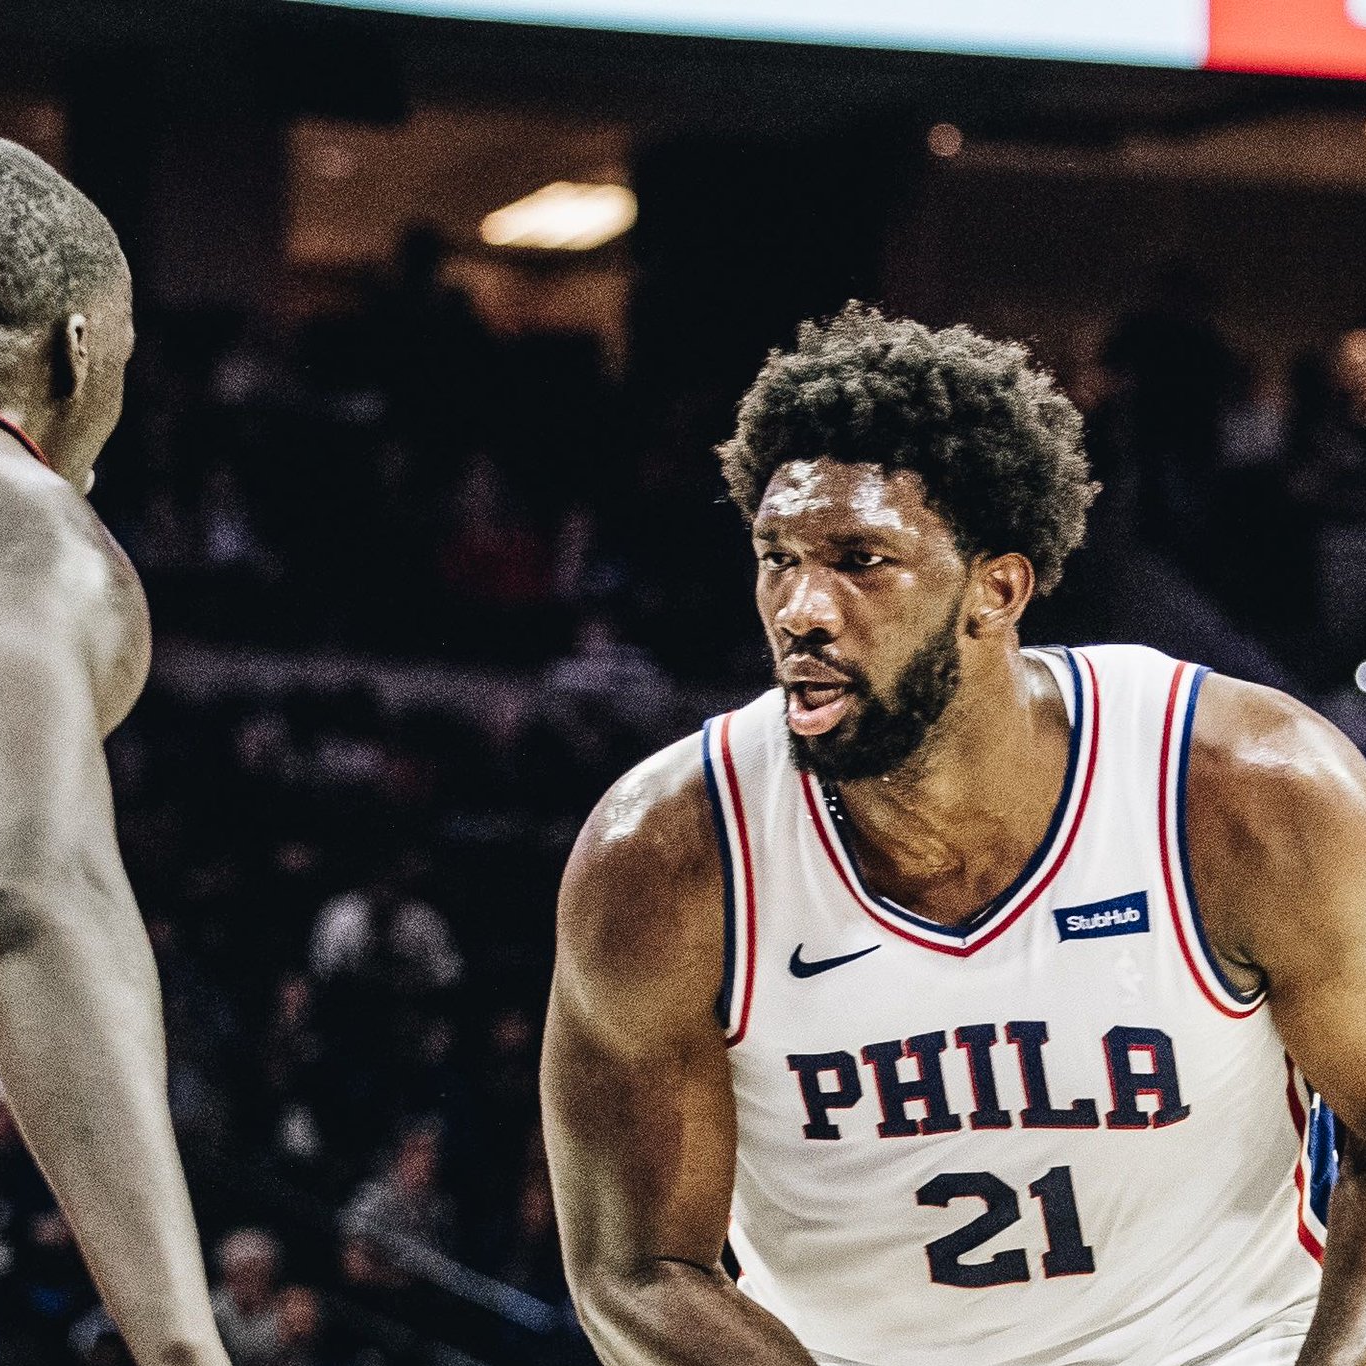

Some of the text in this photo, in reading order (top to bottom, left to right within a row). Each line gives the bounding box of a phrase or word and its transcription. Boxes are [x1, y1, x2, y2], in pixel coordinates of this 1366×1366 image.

[1066, 907, 1141, 931] StubHub
[787, 1020, 1191, 1141] PHILA
[916, 1165, 1095, 1288] 21
